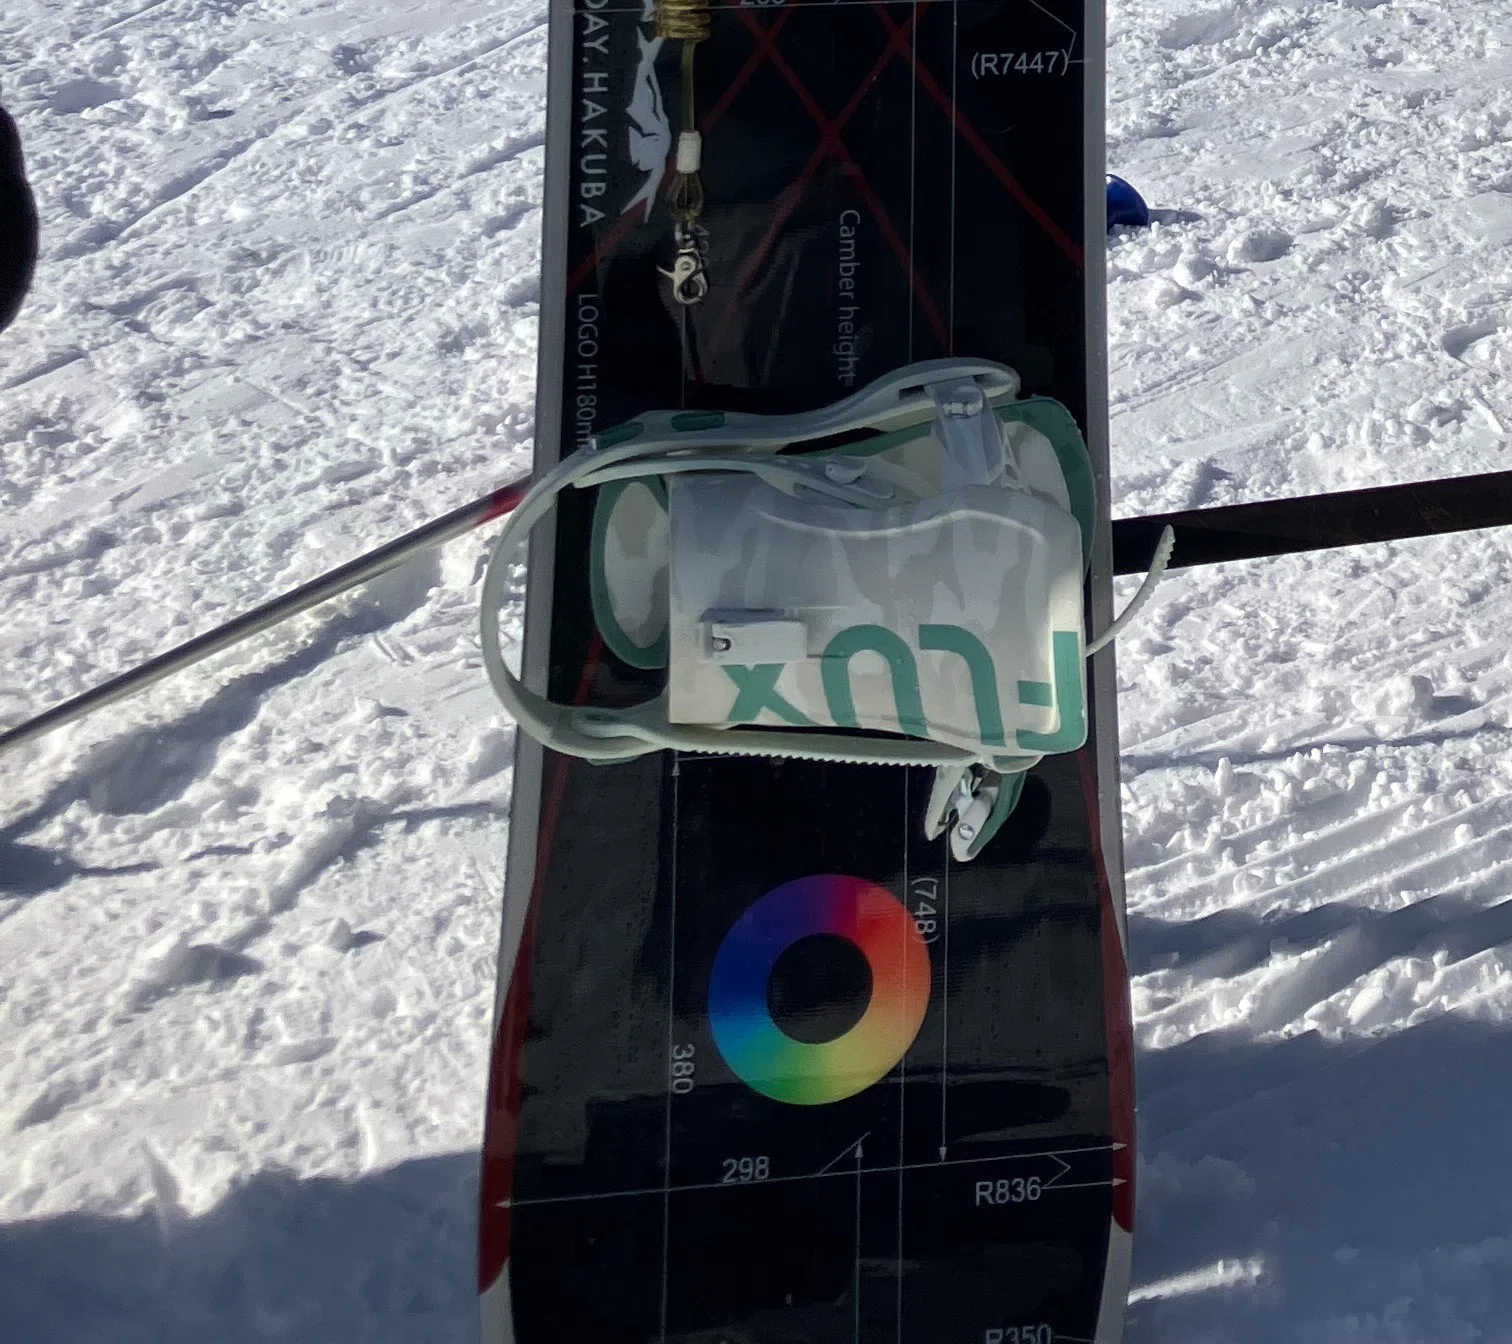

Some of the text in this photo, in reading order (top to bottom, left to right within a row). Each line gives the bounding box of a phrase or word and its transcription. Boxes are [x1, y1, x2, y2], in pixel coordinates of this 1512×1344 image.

[971, 49, 1070, 79] (R7447)
[832, 209, 861, 387] Camber height
[575, 293, 600, 450] LOGO H180m
[911, 876, 939, 945] (748)
[671, 1043, 696, 1095] 380
[722, 1157, 770, 1183] 298
[974, 1177, 1041, 1206] R836
